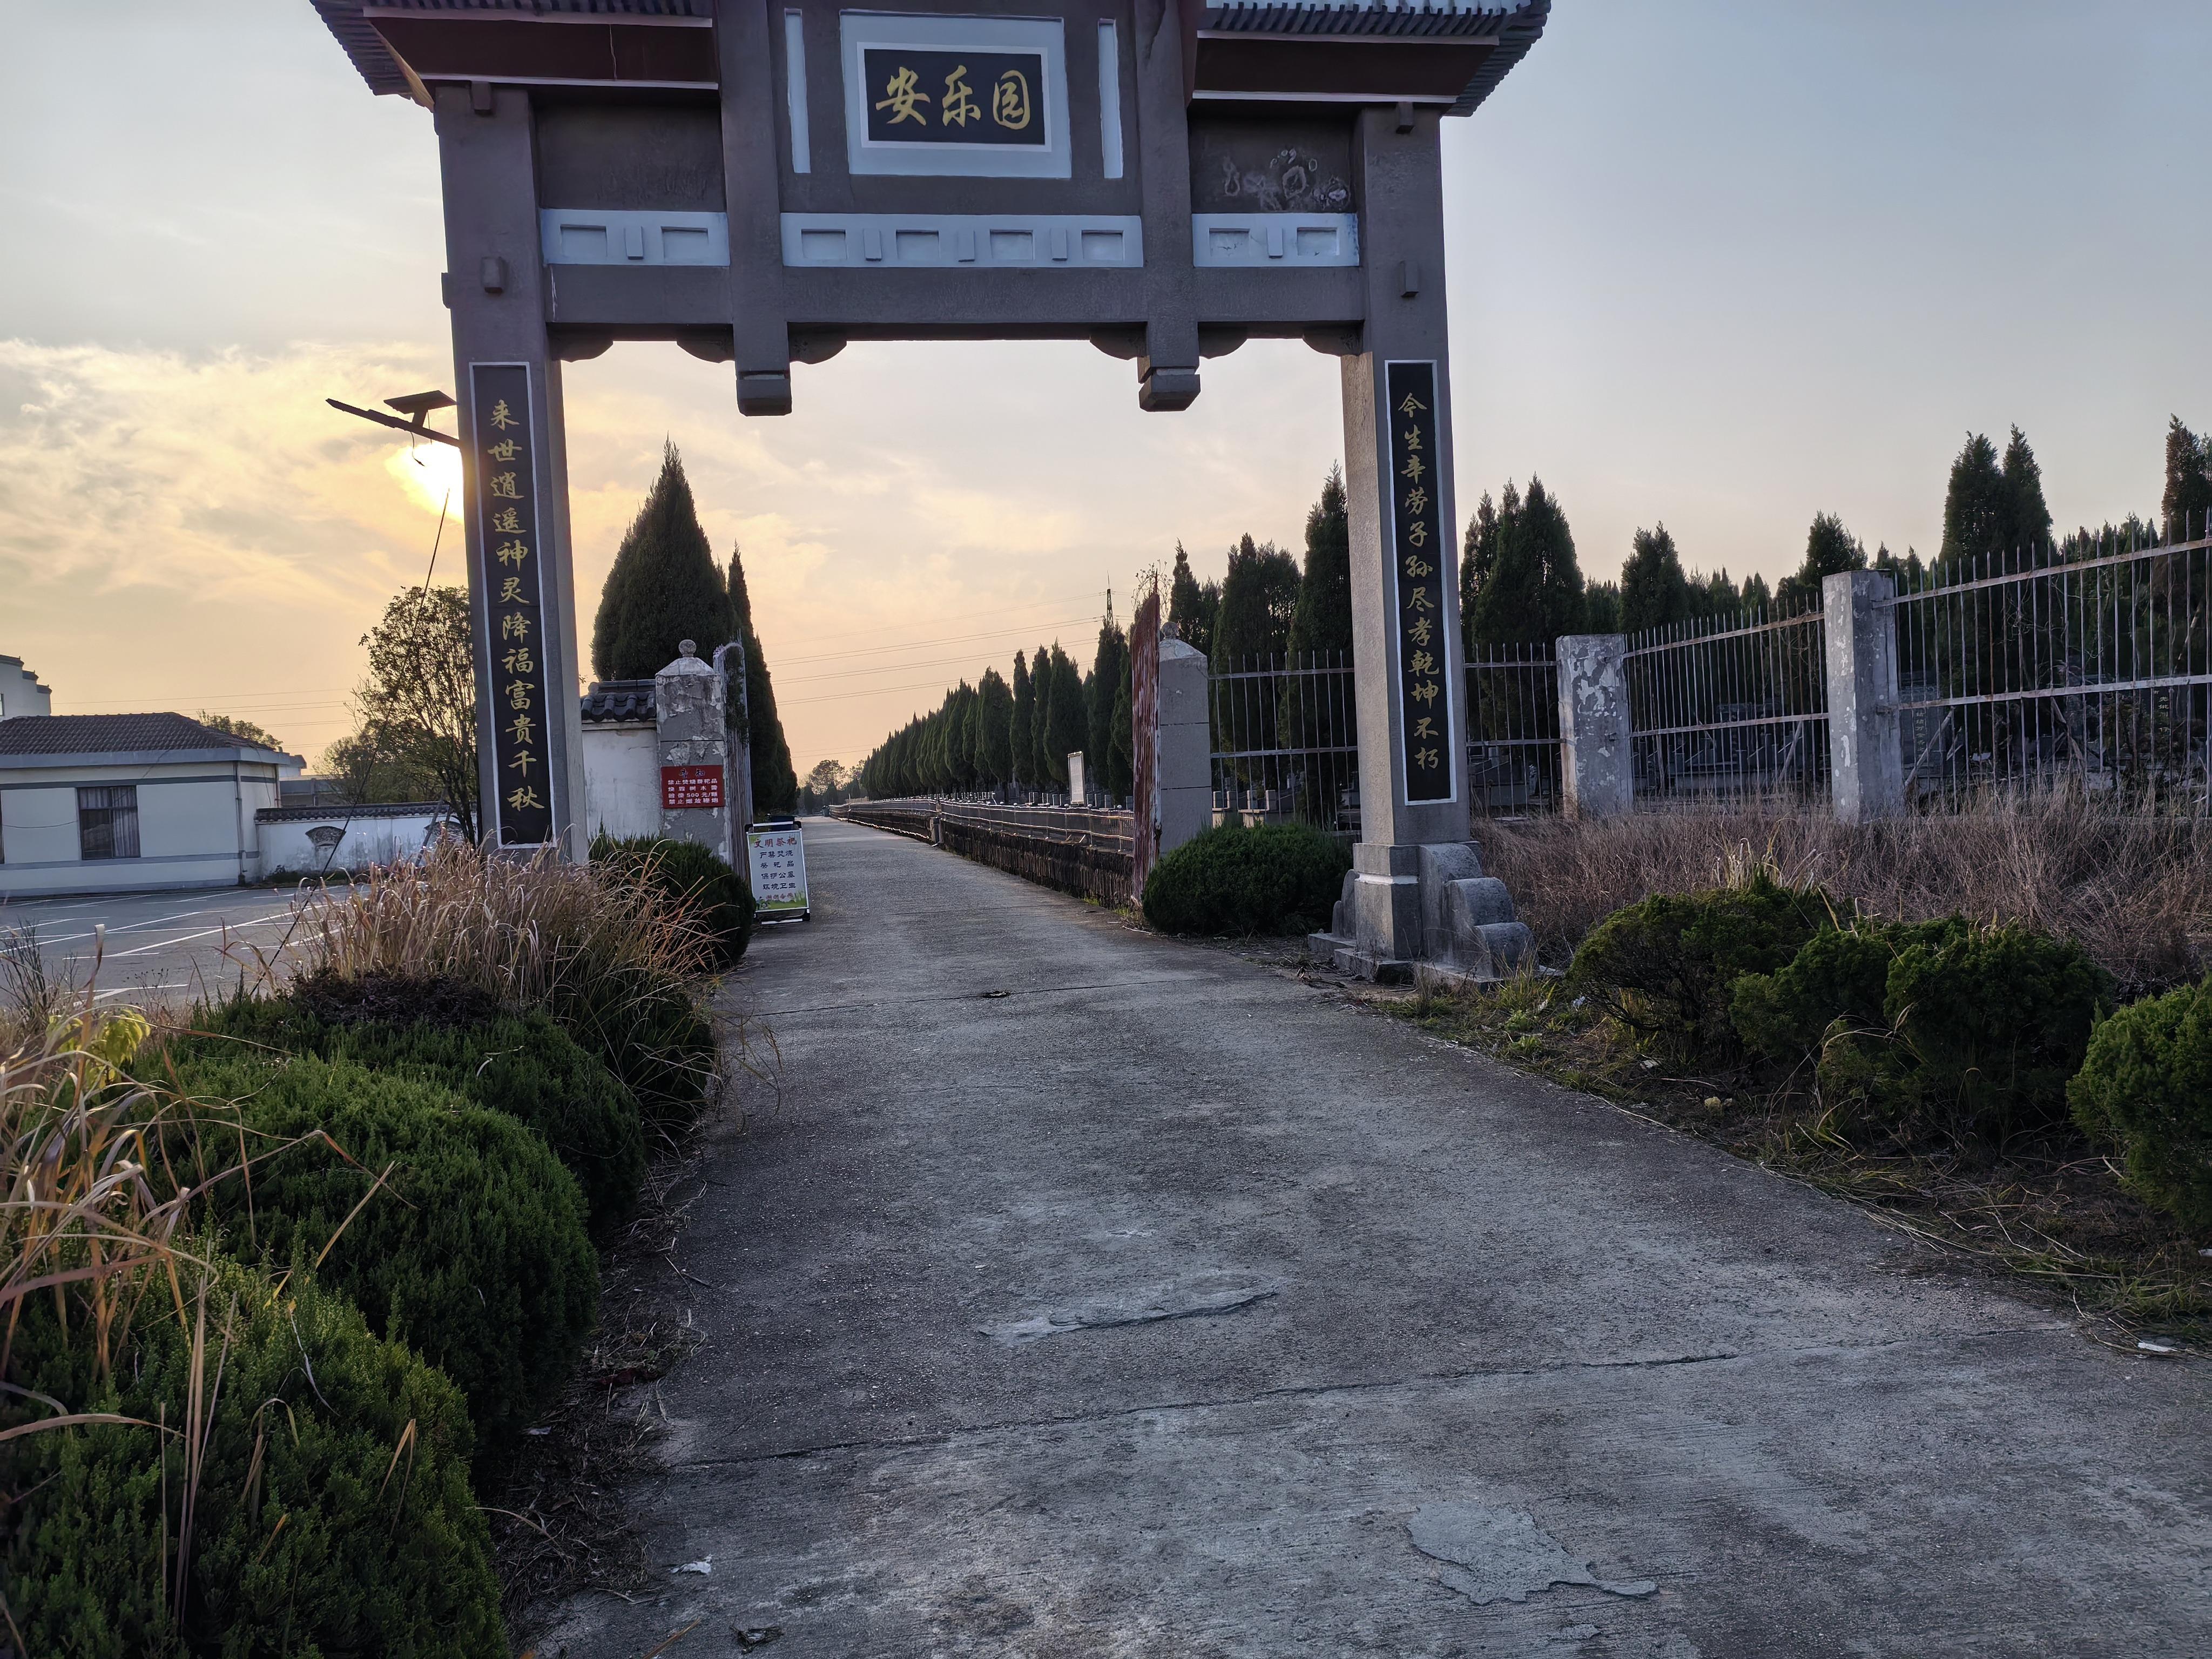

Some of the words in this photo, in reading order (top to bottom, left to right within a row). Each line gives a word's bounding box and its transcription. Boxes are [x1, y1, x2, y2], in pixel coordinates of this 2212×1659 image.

[875, 64, 1031, 130] 安乐园
[1398, 392, 1440, 770] 今生辛劳子孙尽孝乾坤不朽
[487, 399, 545, 812] 来世逍遥神灵降福富贵千秋
[754, 837, 797, 848] 文明祭祀
[760, 850, 794, 859] 严禁焚烧
[760, 860, 794, 868] 祭祀品
[761, 871, 795, 880] 保护公墓
[763, 882, 796, 891] 环境卫生
